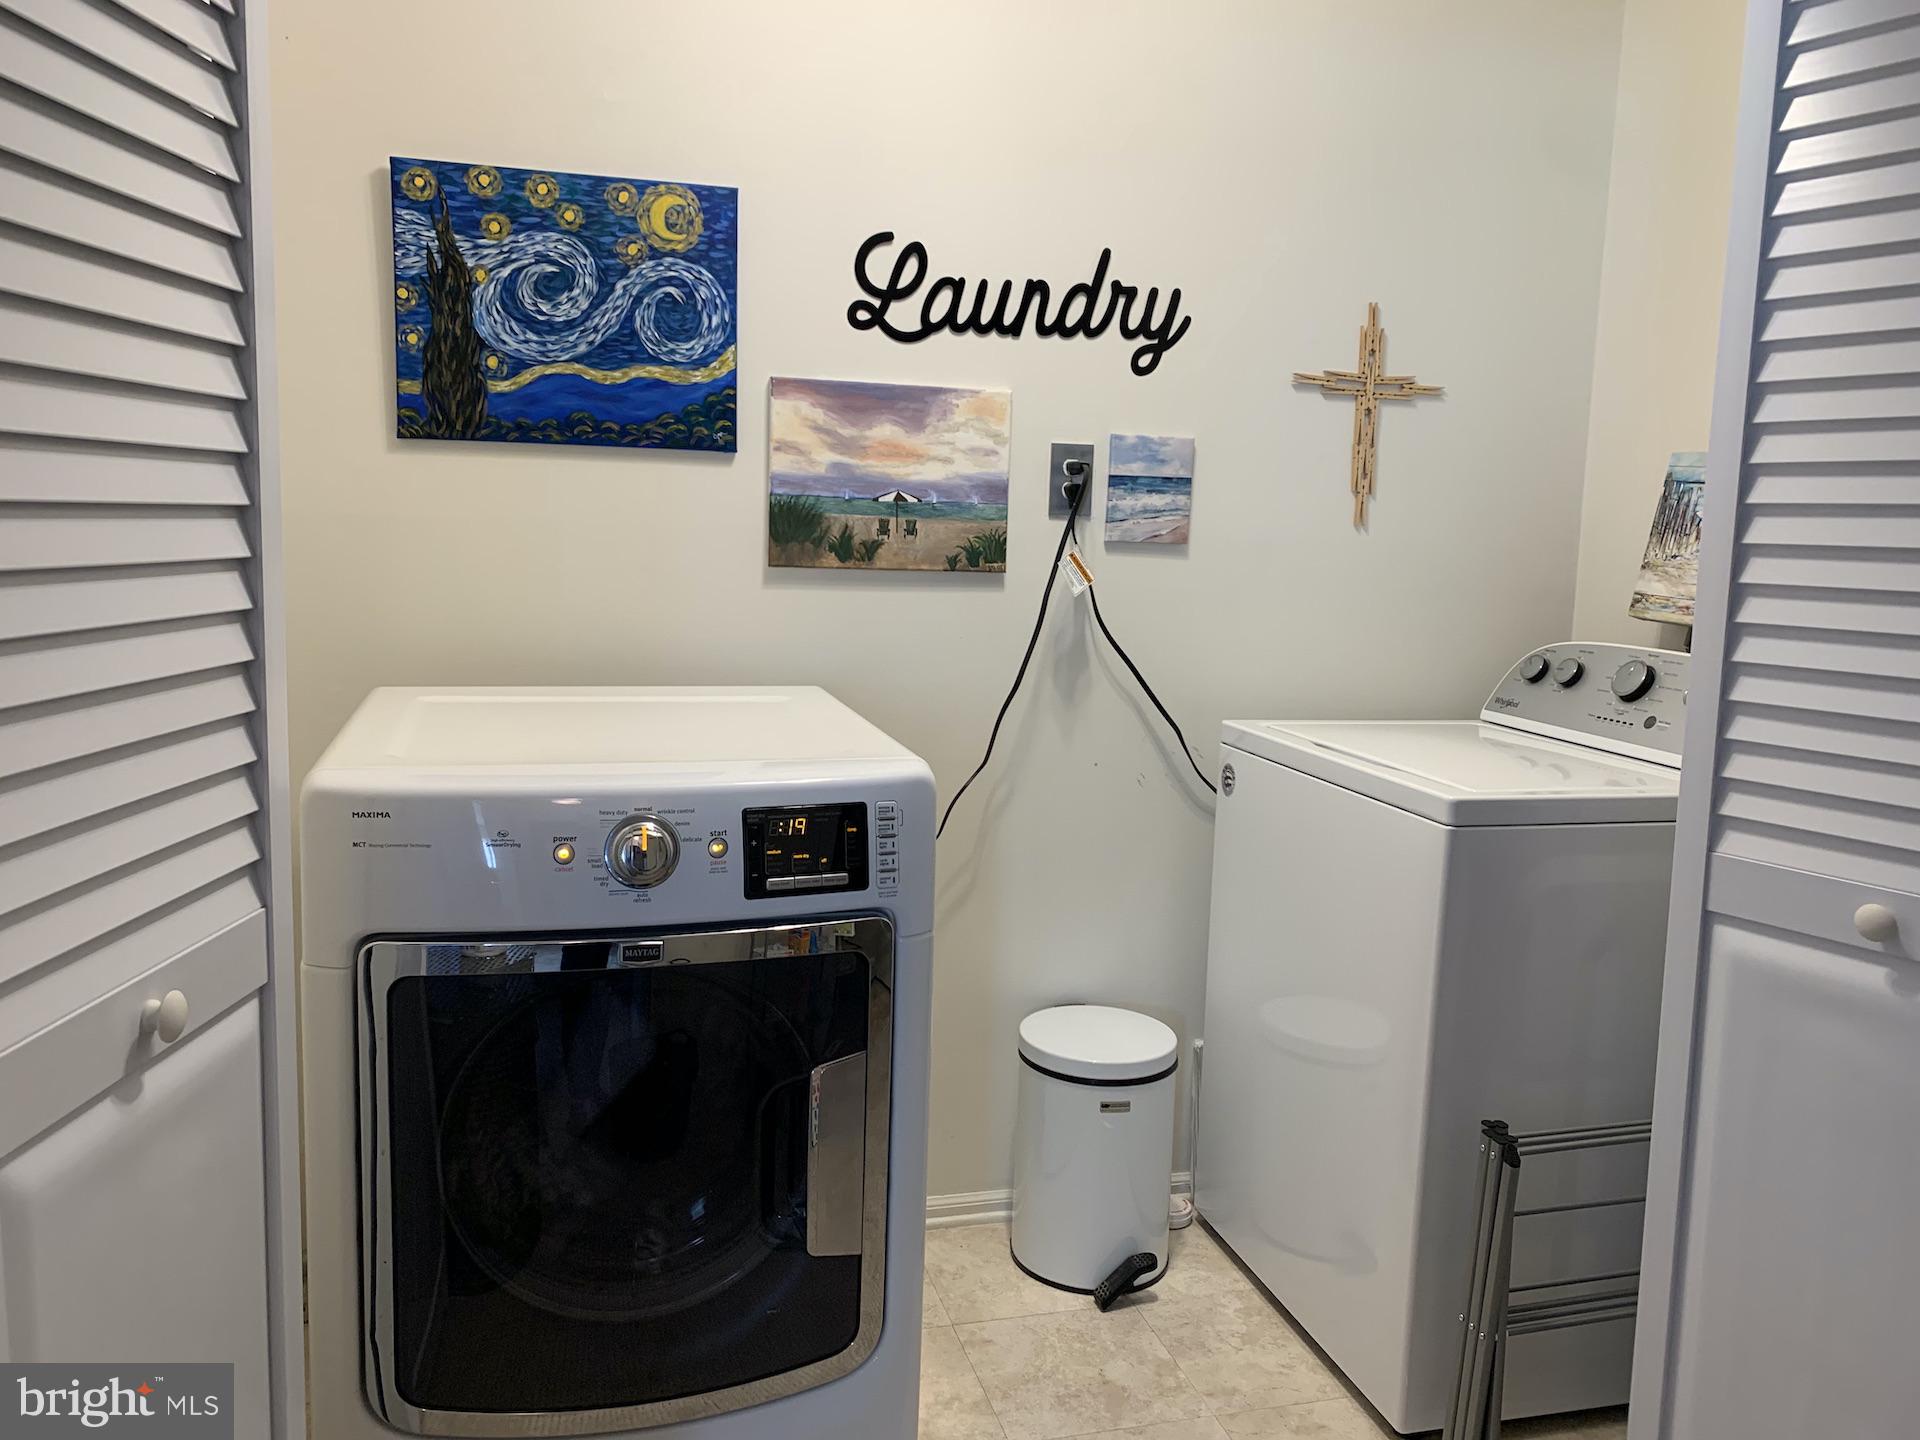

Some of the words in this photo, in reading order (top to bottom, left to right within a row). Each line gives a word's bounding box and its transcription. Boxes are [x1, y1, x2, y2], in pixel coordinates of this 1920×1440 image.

[847, 230, 1192, 377] Laundry
[352, 811, 391, 819] MAXIMA
[709, 829, 727, 837] start
[552, 835, 577, 843] power
[624, 947, 659, 958] MAYTAG
